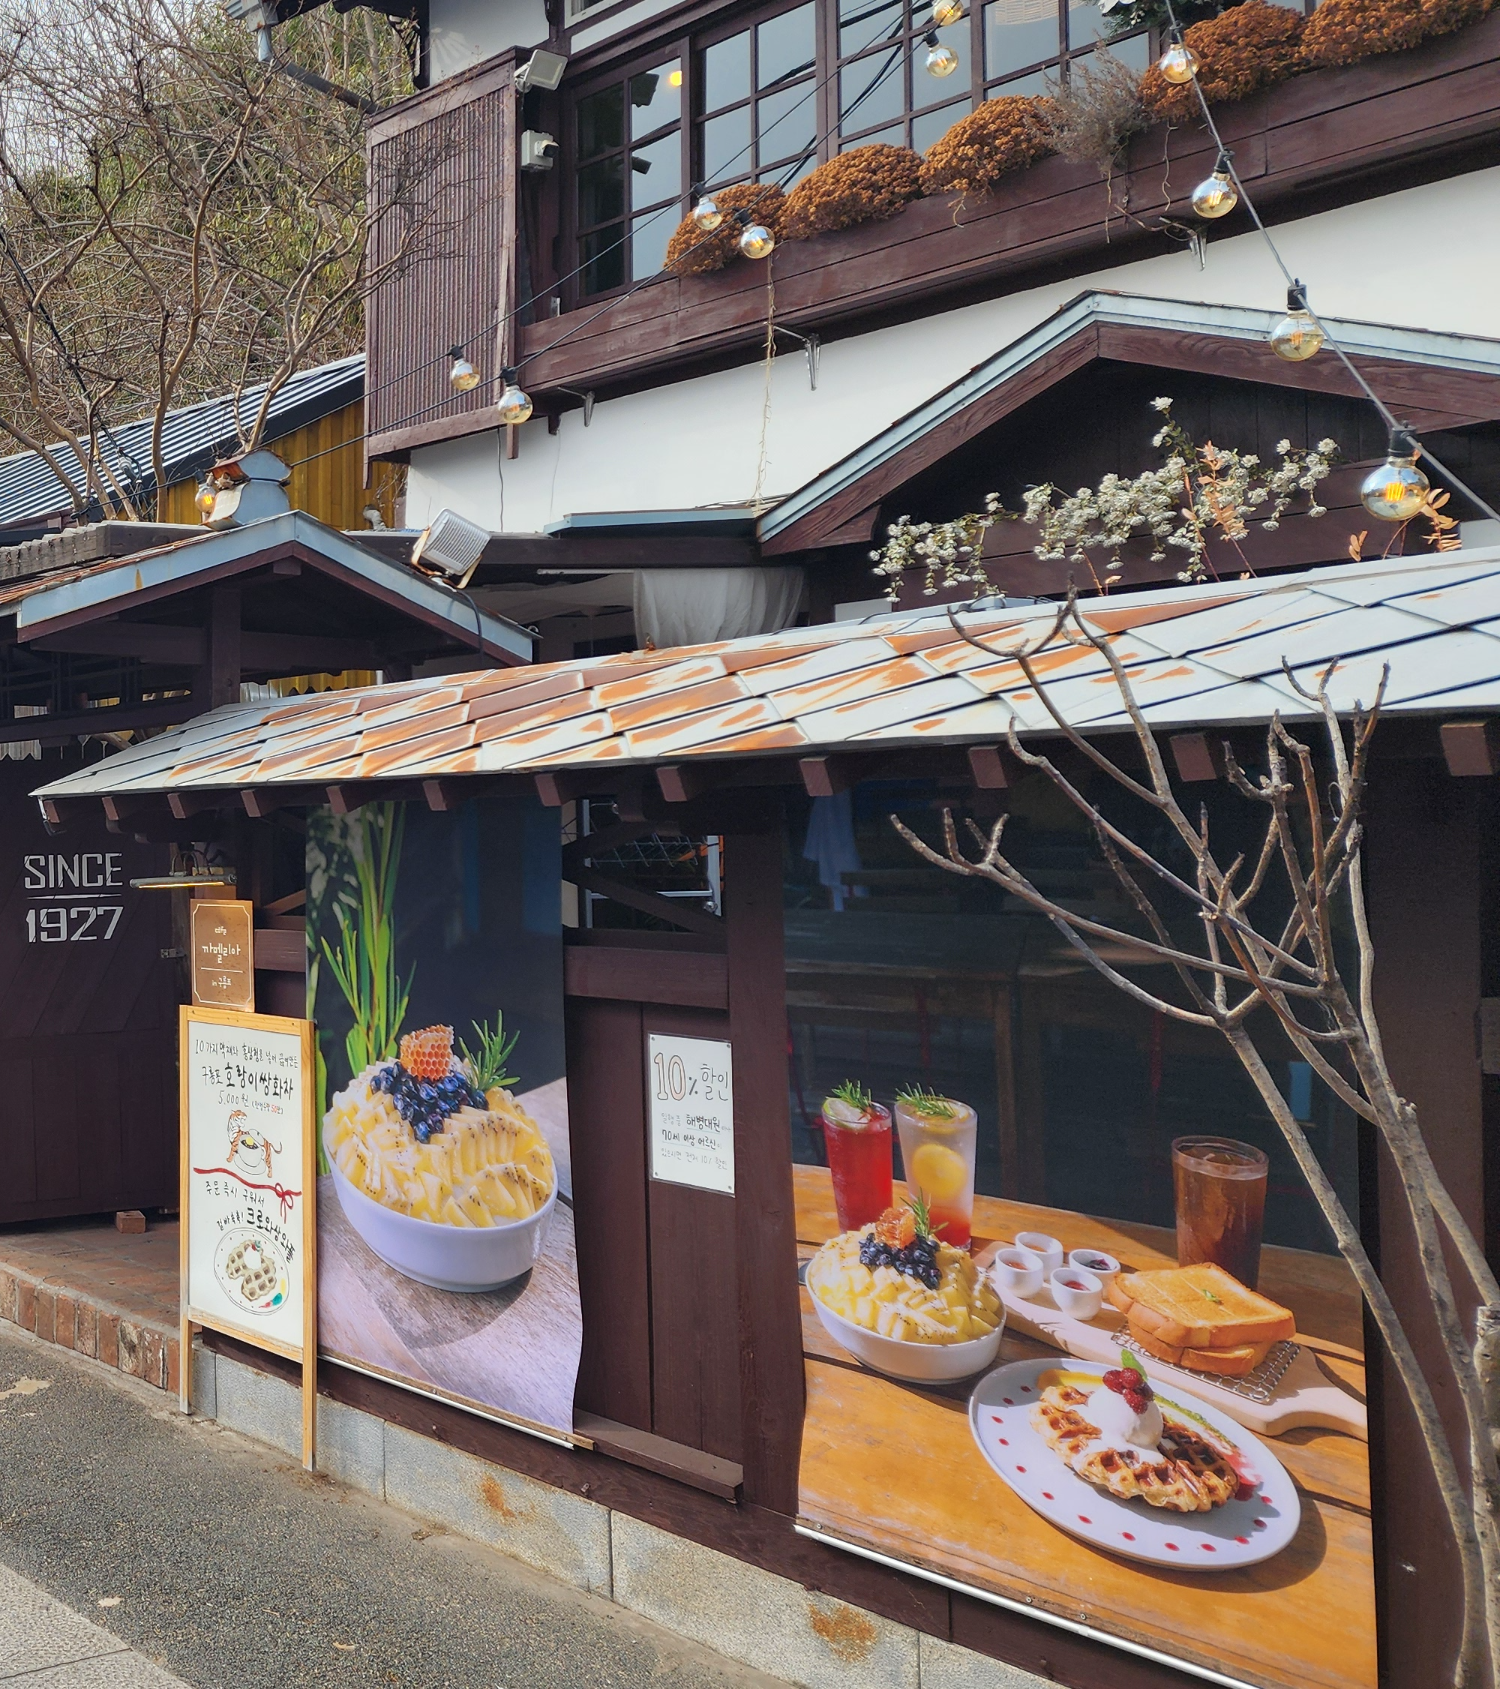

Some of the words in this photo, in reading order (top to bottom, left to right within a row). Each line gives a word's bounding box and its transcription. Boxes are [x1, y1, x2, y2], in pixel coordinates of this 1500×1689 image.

[23, 852, 123, 889] SINCE
[25, 906, 124, 943] 1927
[201, 942, 241, 964] 까멜리아
[202, 1065, 223, 1086] 구룡포
[224, 1062, 294, 1100] 호랑이쌍화차
[654, 1051, 699, 1102] 10%
[700, 1063, 729, 1102] 할인
[662, 1129, 680, 1142] 70세
[683, 1134, 695, 1147] 이상
[224, 1181, 237, 1198] 즉시
[243, 1188, 265, 1207] 구워서
